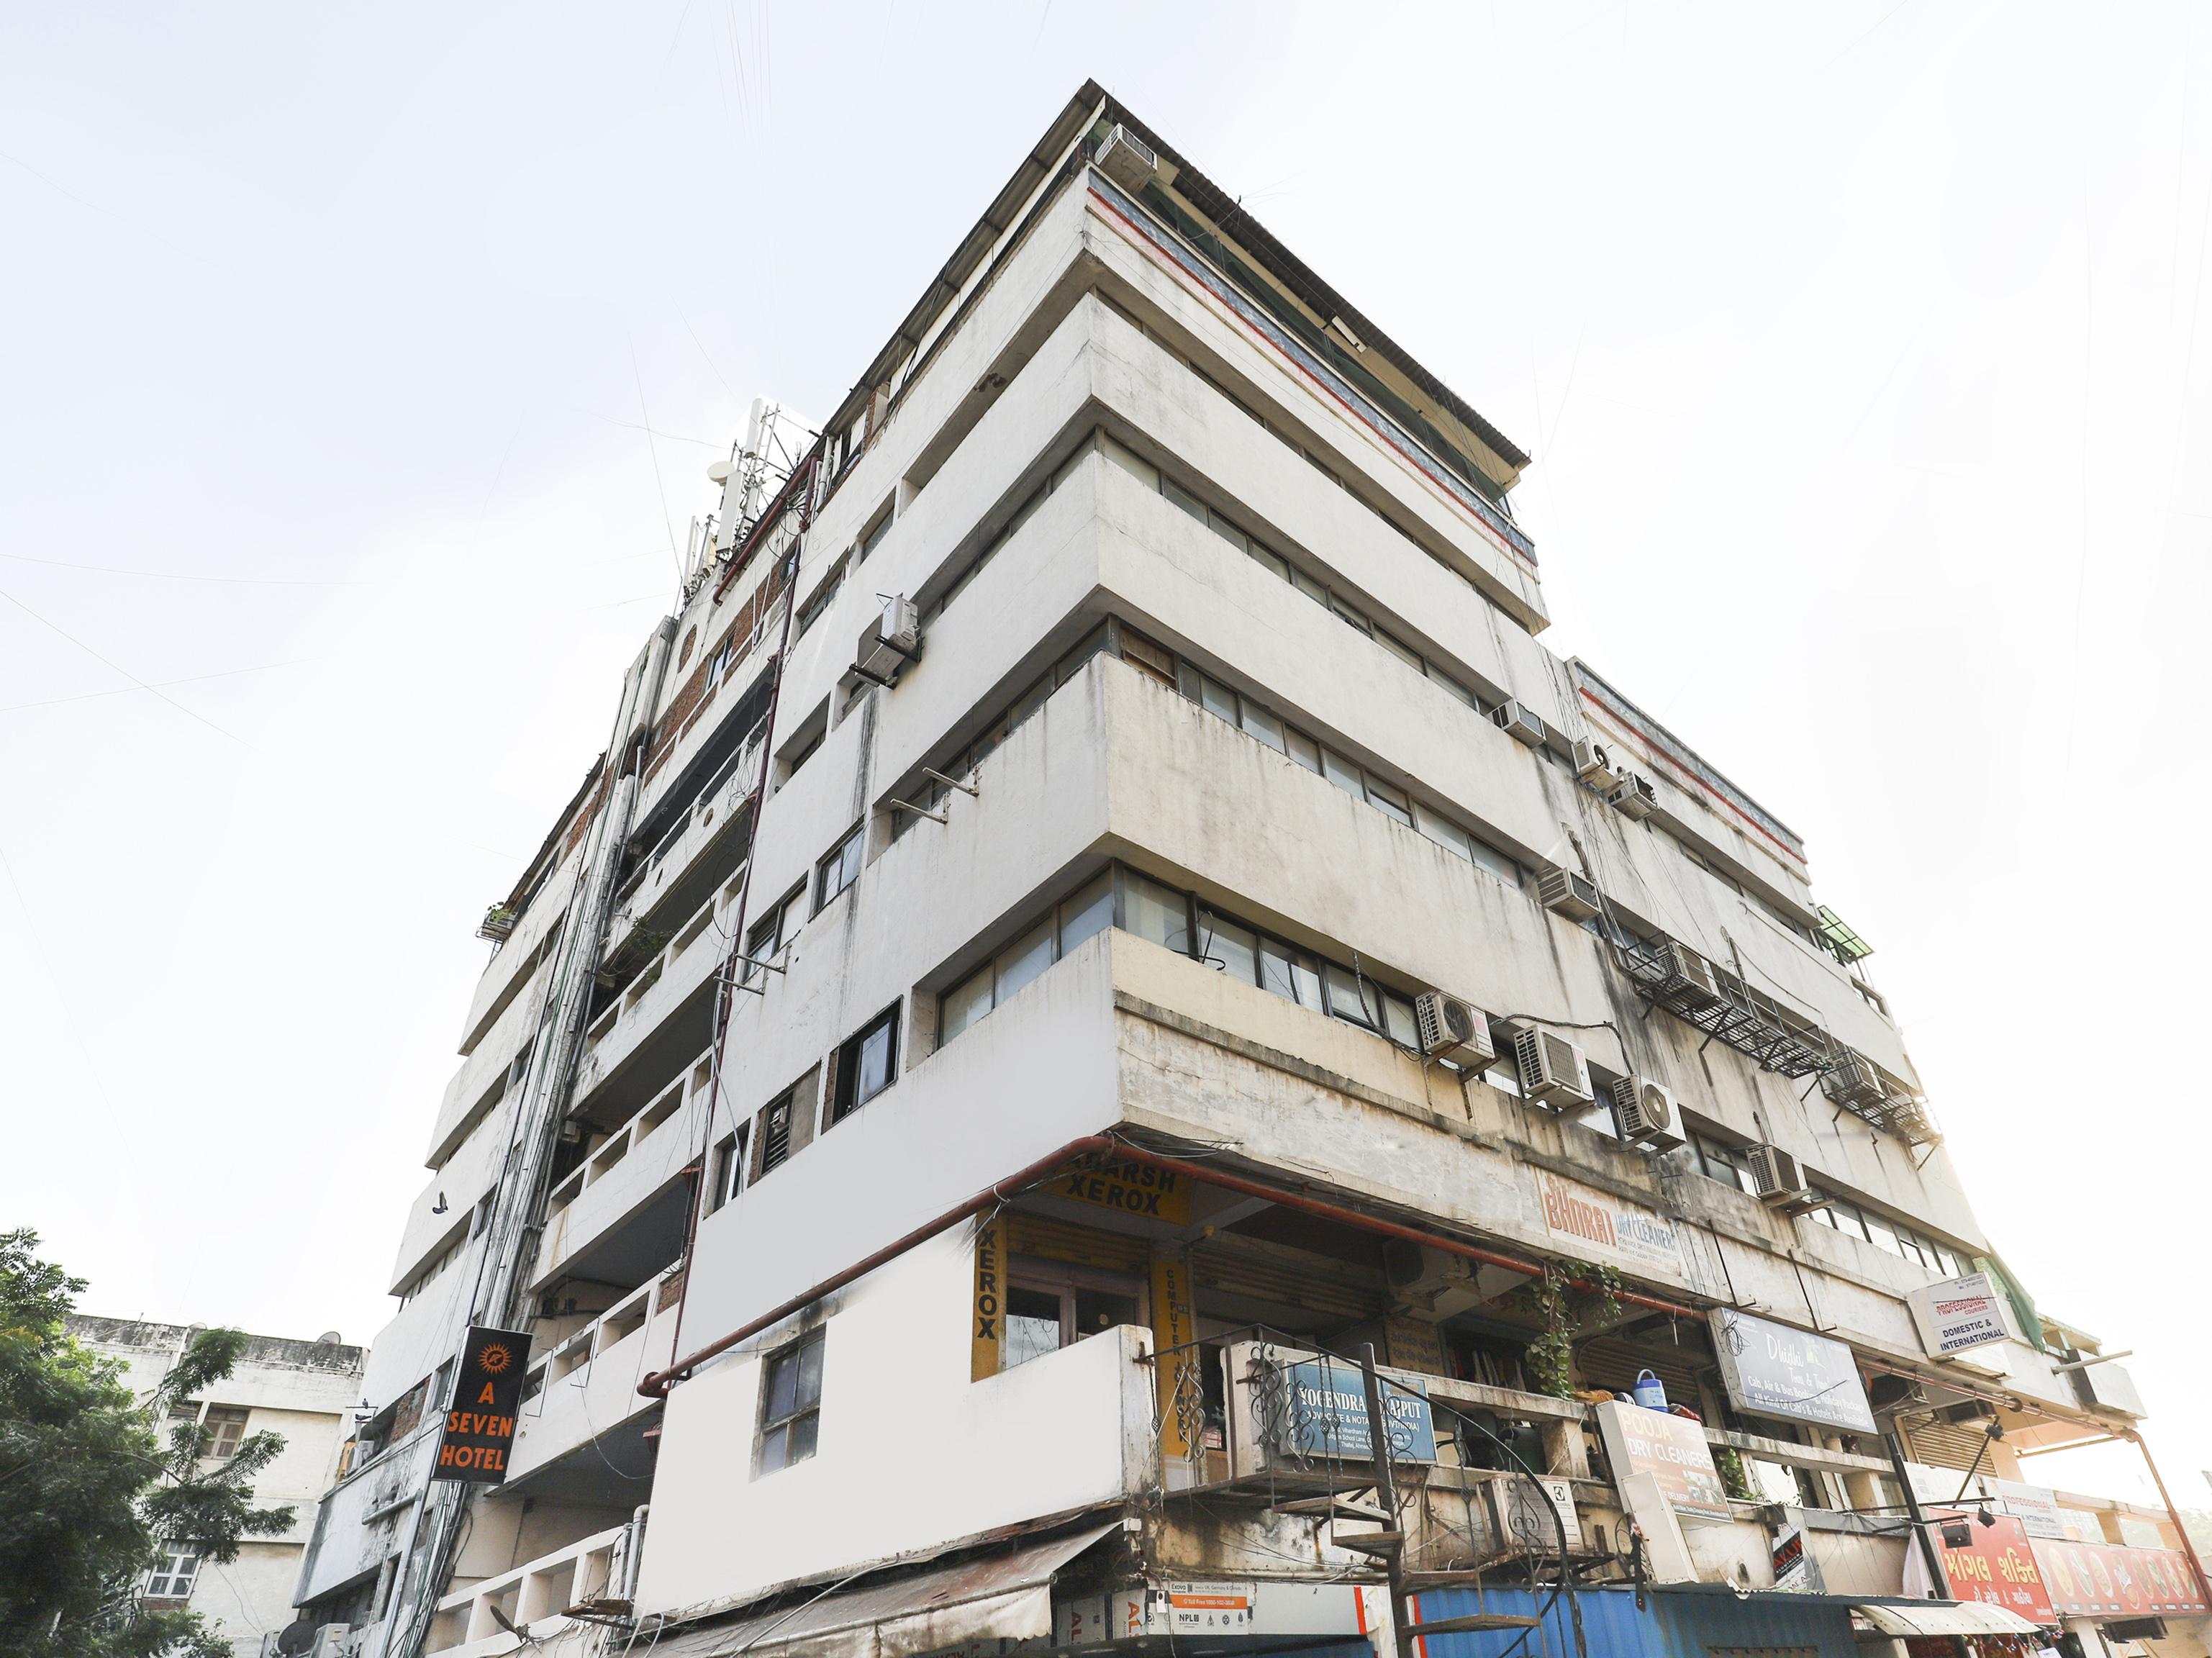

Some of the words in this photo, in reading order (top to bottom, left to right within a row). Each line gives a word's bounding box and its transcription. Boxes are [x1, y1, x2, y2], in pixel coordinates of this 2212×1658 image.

[1067, 1174, 1161, 1215] XEROX
[976, 1228, 997, 1341] XEROX
[1167, 1269, 1180, 1356] COMPUTER
[1940, 1328, 2004, 1351] INTERNATIONAL
[1943, 1320, 1984, 1338] DOMESTIC
[1985, 1318, 1993, 1327] &
[478, 1382, 494, 1404] A
[1299, 1387, 1366, 1412] YOGENDRA
[1764, 1380, 1774, 1392] Air
[1774, 1382, 1781, 1393] &
[1780, 1384, 1794, 1396] Bus
[1307, 1411, 1345, 1423] ADVCE
[1346, 1415, 1351, 1423] &
[1352, 1415, 1369, 1425] NOTA
[1754, 1392, 1764, 1404] All
[1806, 1405, 1813, 1415] &
[1813, 1406, 1832, 1421] Hotels
[448, 1411, 514, 1438] SEVEN
[1620, 1409, 1673, 1441] POOJA
[439, 1444, 504, 1471] HOTEL
[1627, 1437, 1652, 1458] DRY
[1655, 1443, 1714, 1471] CLEANERS
[1179, 1613, 1193, 1622] NPL
